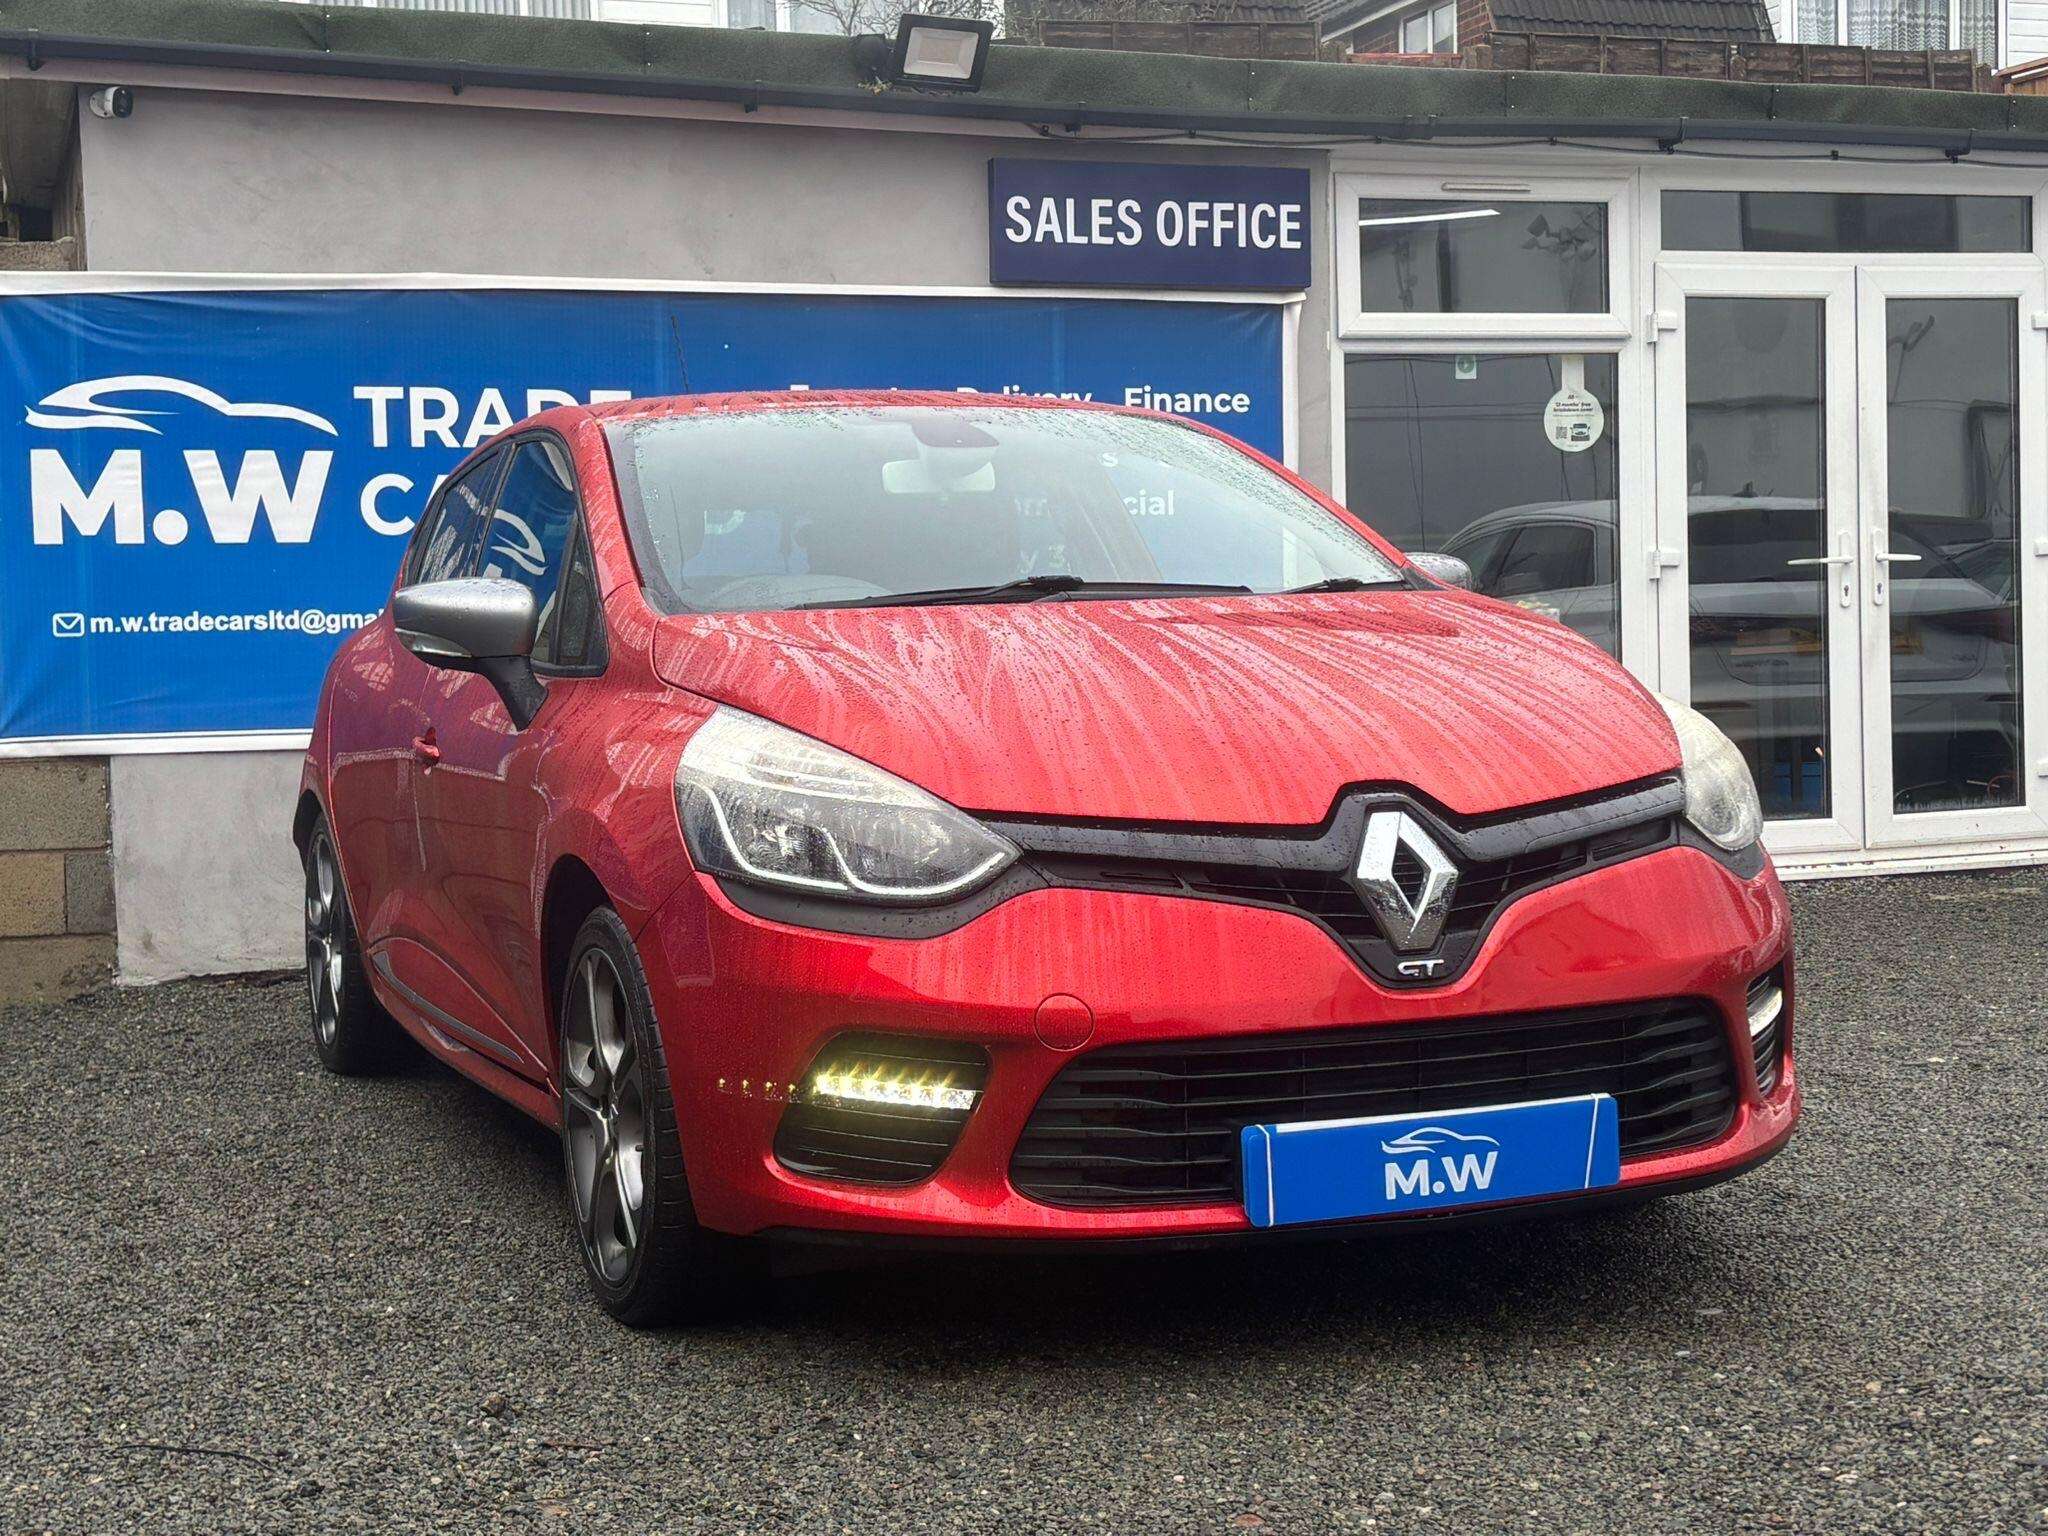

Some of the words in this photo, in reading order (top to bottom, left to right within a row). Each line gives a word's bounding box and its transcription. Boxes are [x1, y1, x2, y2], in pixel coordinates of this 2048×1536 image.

[1005, 195, 1143, 246] SALES
[1156, 200, 1302, 249] OFFICE
[353, 386, 632, 447] TRA
[1124, 385, 1251, 413] Finance
[30, 449, 334, 545] M.W
[1397, 959, 1444, 976] GT
[1384, 1150, 1499, 1201] M.W
